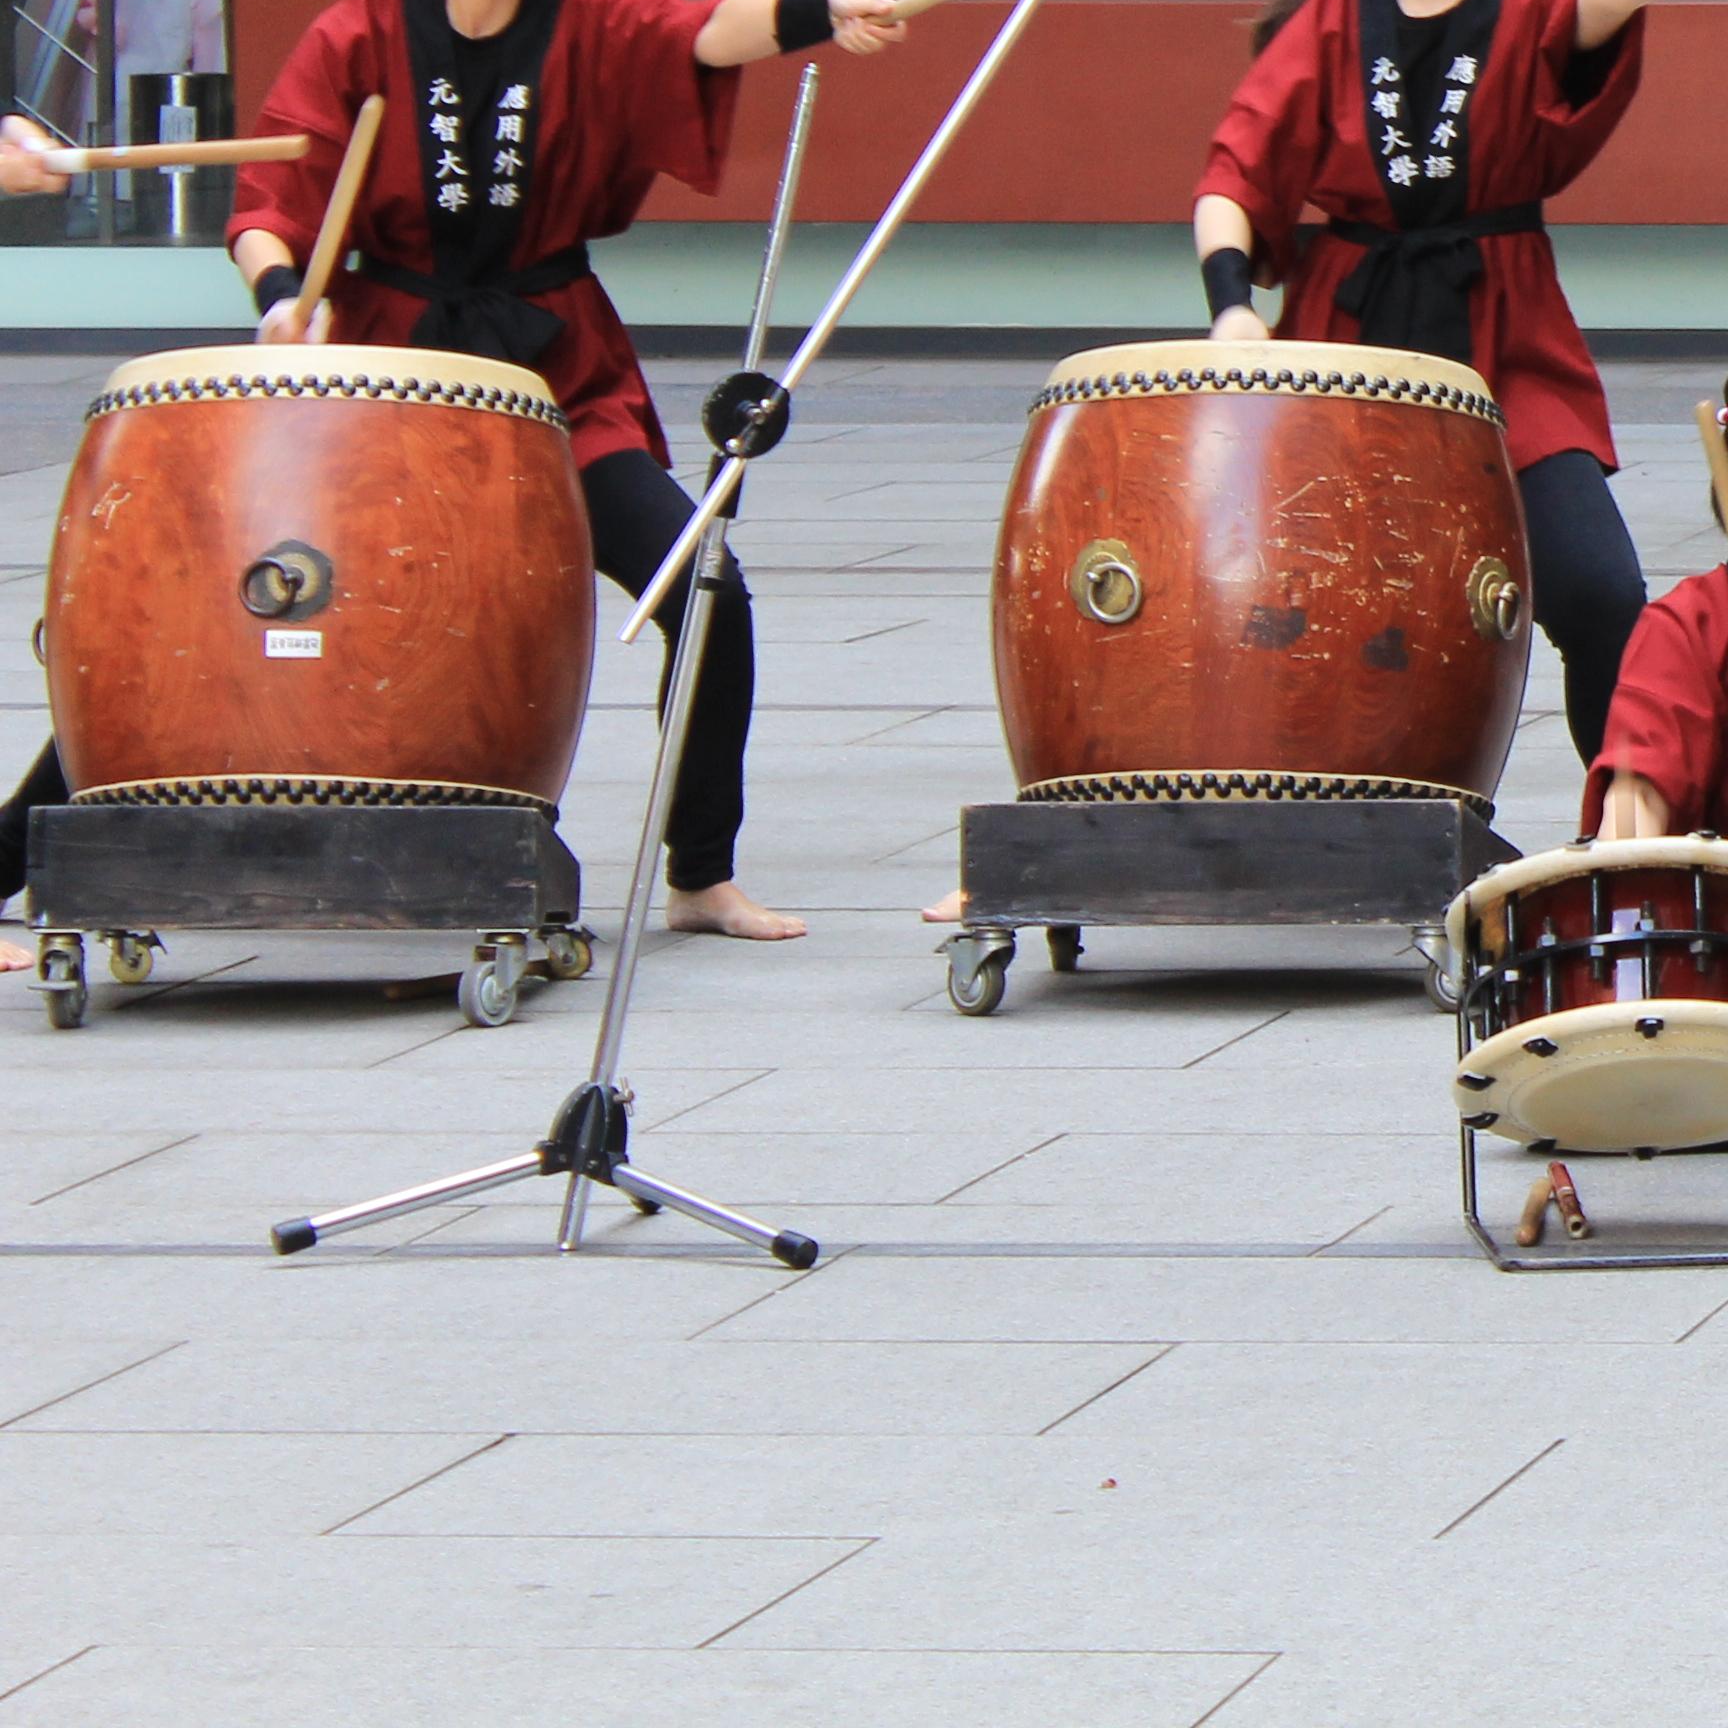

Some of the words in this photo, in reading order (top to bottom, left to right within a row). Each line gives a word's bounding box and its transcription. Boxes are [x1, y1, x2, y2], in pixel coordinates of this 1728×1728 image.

[427, 77, 470, 213] 元智大學
[488, 83, 531, 207] 應用外語
[1371, 56, 1420, 187] 元智大學
